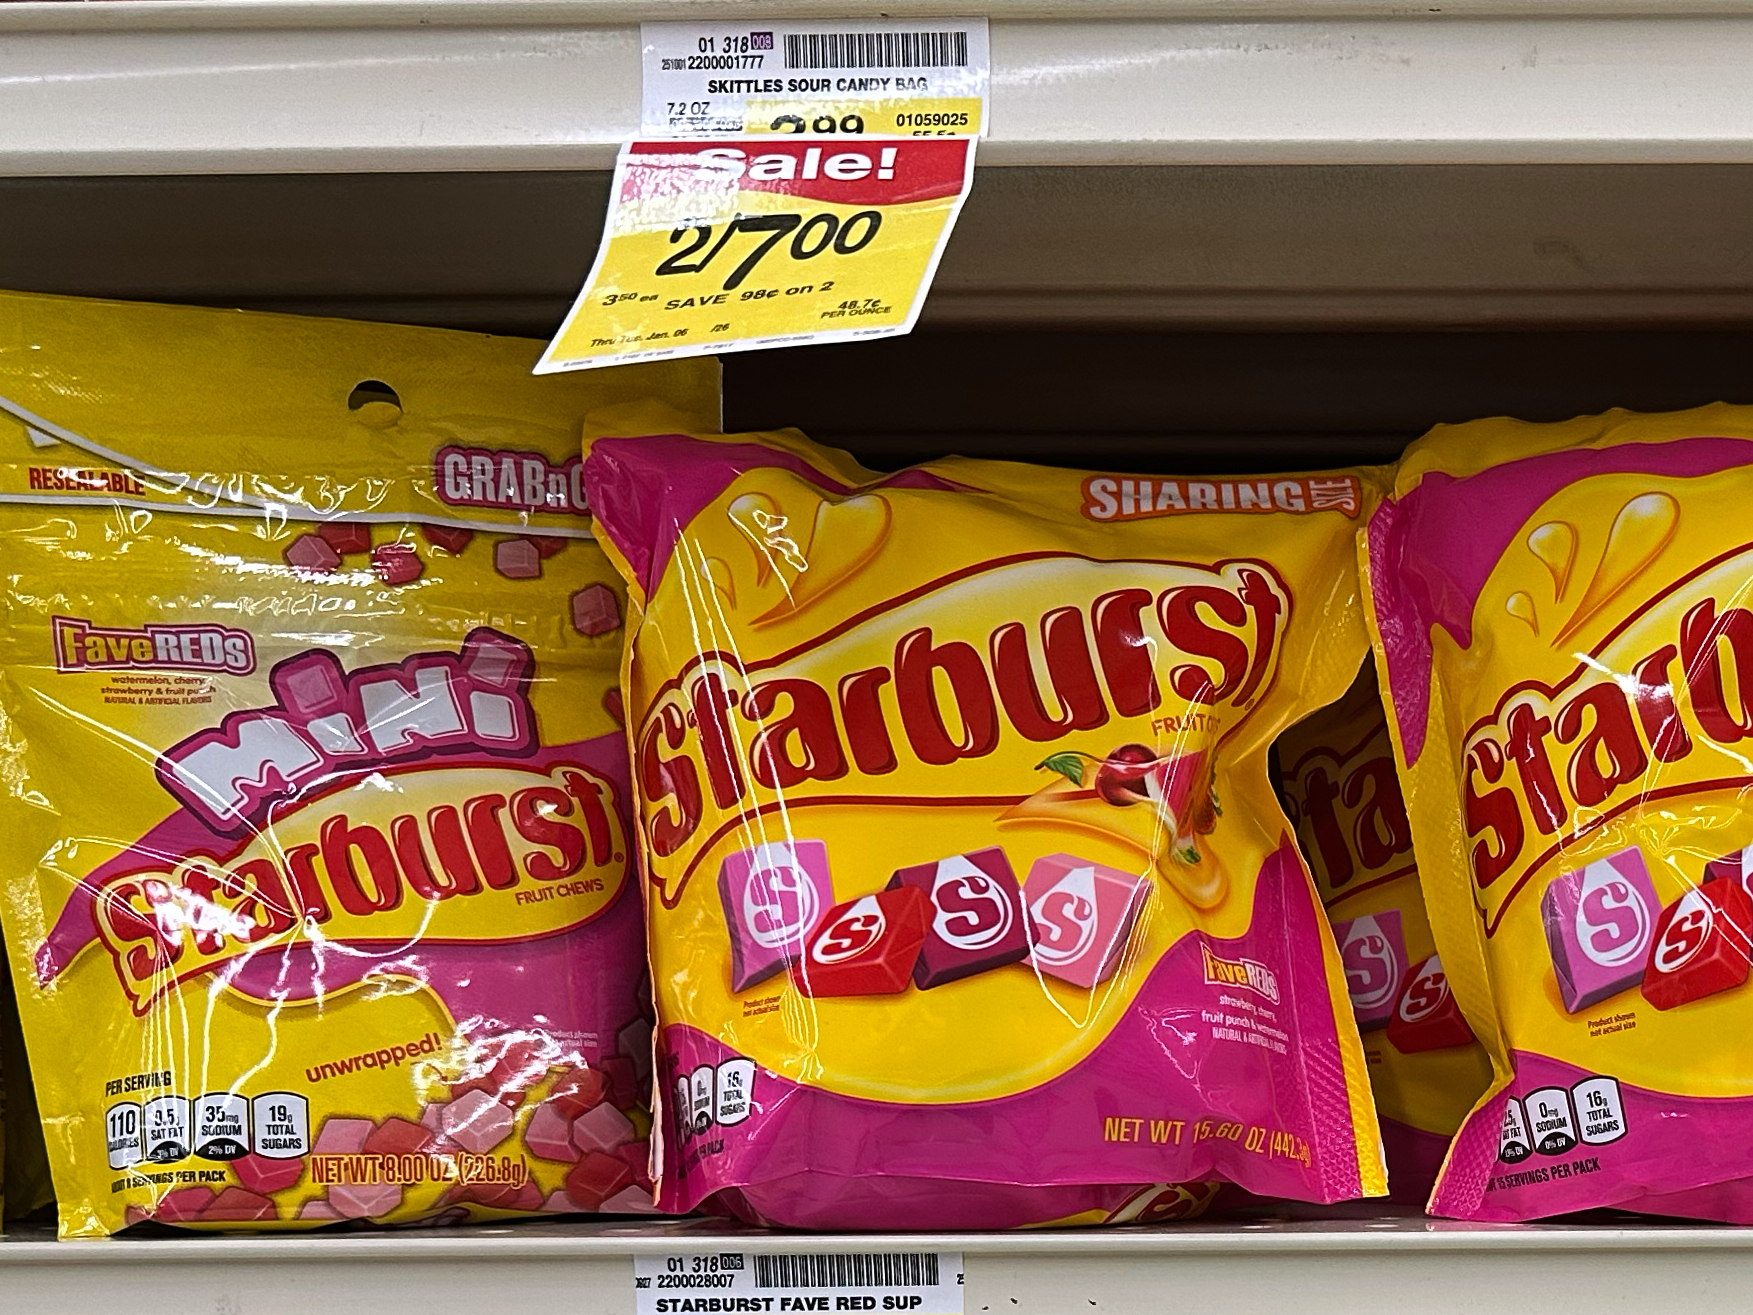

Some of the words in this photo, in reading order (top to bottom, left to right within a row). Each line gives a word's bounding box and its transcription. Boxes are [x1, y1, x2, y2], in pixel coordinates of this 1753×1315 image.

[688, 56, 764, 70] 2200001777
[708, 80, 783, 93] SKITTLES
[788, 79, 831, 92] SOUR
[836, 78, 889, 91] CANDY
[895, 77, 928, 91] BAG
[667, 103, 685, 115] 7.2
[691, 102, 710, 115] OZ
[896, 113, 968, 126] 01059025
[699, 148, 897, 181] Sale!
[664, 294, 730, 310] SAVE
[740, 289, 779, 302] 98¢
[785, 284, 812, 296] on
[819, 281, 835, 291] 2
[29, 467, 146, 497] RESEALABLE
[1308, 479, 1356, 512] SIZE
[1088, 478, 1305, 516] SHARING
[639, 568, 1282, 858] Starburst
[1150, 715, 1200, 738] FRUIT
[101, 774, 614, 973] Starburst
[515, 883, 555, 906] FRUIT
[559, 878, 604, 901] CHEWS
[305, 1032, 443, 1082] unwrapped!
[1105, 1117, 1144, 1142] NET
[1150, 1120, 1185, 1145] WT
[1193, 1121, 1244, 1143] 15.60
[1245, 1127, 1266, 1153] OZ
[312, 1156, 344, 1183] NET
[350, 1156, 380, 1182] WT
[386, 1156, 422, 1181] 8.00
[657, 1274, 734, 1288] 2200028007
[656, 1298, 774, 1312] STARBURST
[780, 1297, 830, 1311] FAVE
[835, 1297, 876, 1311] RED
[882, 1296, 922, 1310] SUP
